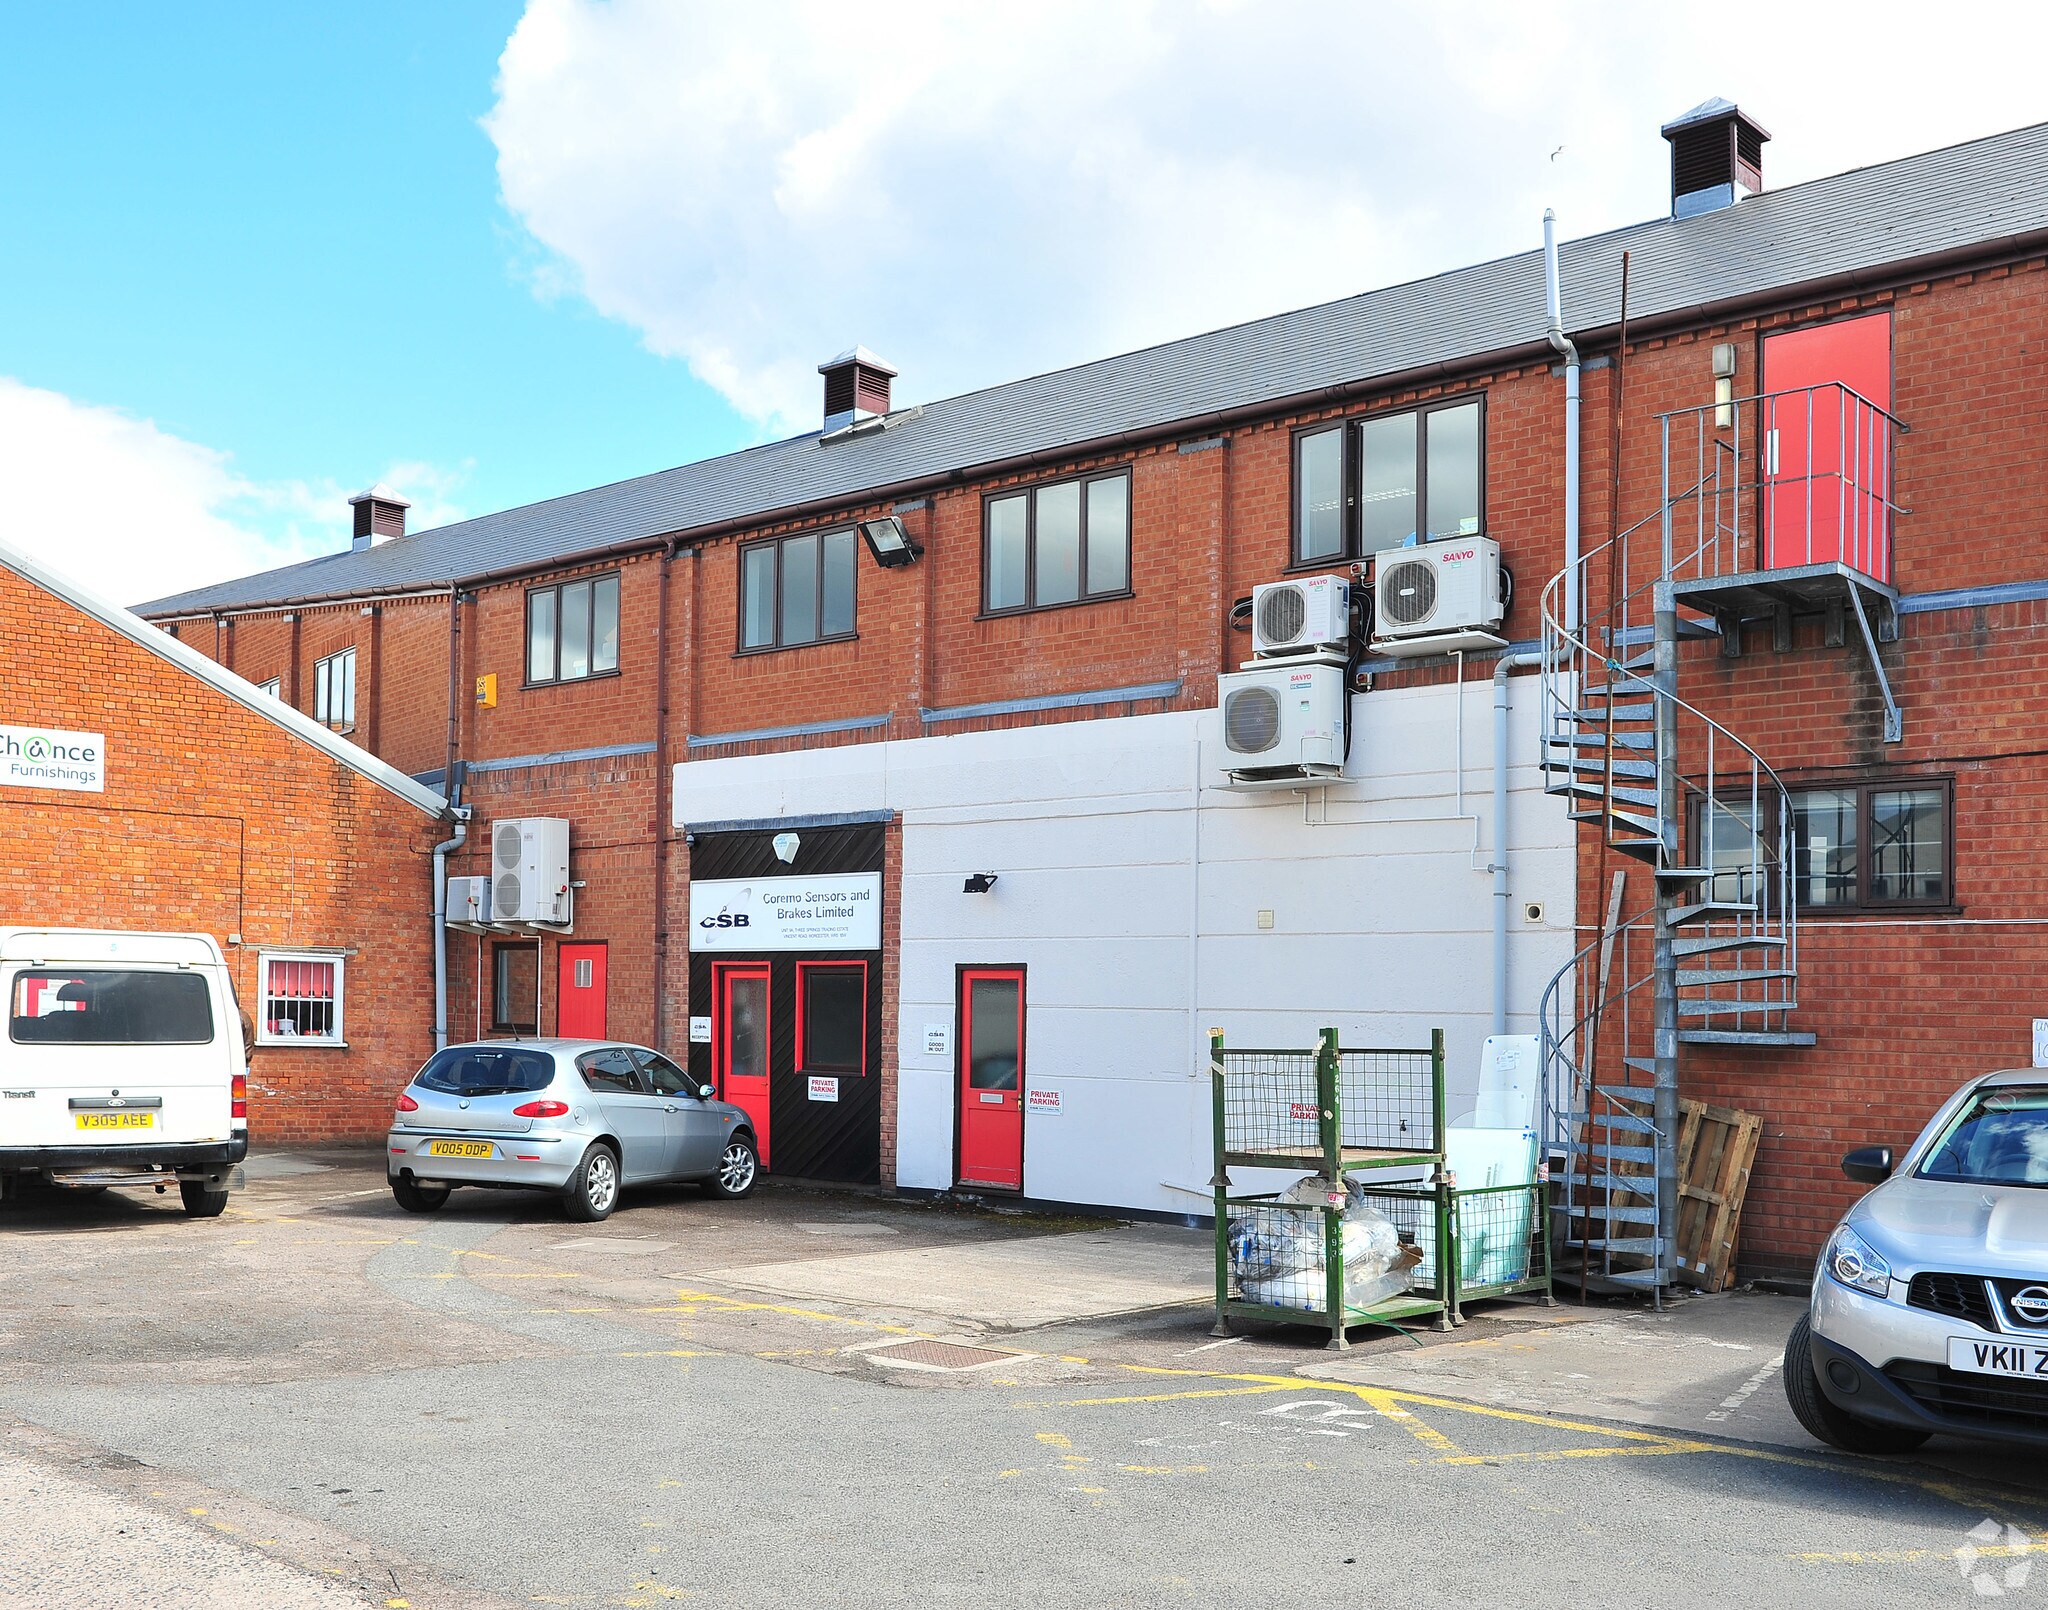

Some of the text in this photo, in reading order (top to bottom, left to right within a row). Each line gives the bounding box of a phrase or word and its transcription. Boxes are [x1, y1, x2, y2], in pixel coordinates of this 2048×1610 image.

[1442, 550, 1474, 562] SANYO
[1308, 579, 1328, 587] SANYO
[1290, 673, 1312, 681] SANYO
[11, 763, 96, 784] Furnishings
[763, 889, 870, 904] Coremo Sensors and
[777, 906, 854, 919] Brakes Limited
[811, 1079, 835, 1087] PRIVATE
[2, 1090, 37, 1099] Transit
[1030, 1090, 1059, 1099] PRIVATE
[1029, 1098, 1060, 1106] PARKING
[82, 1114, 148, 1127] V309 AEE
[1973, 1343, 2025, 1372] VK11
